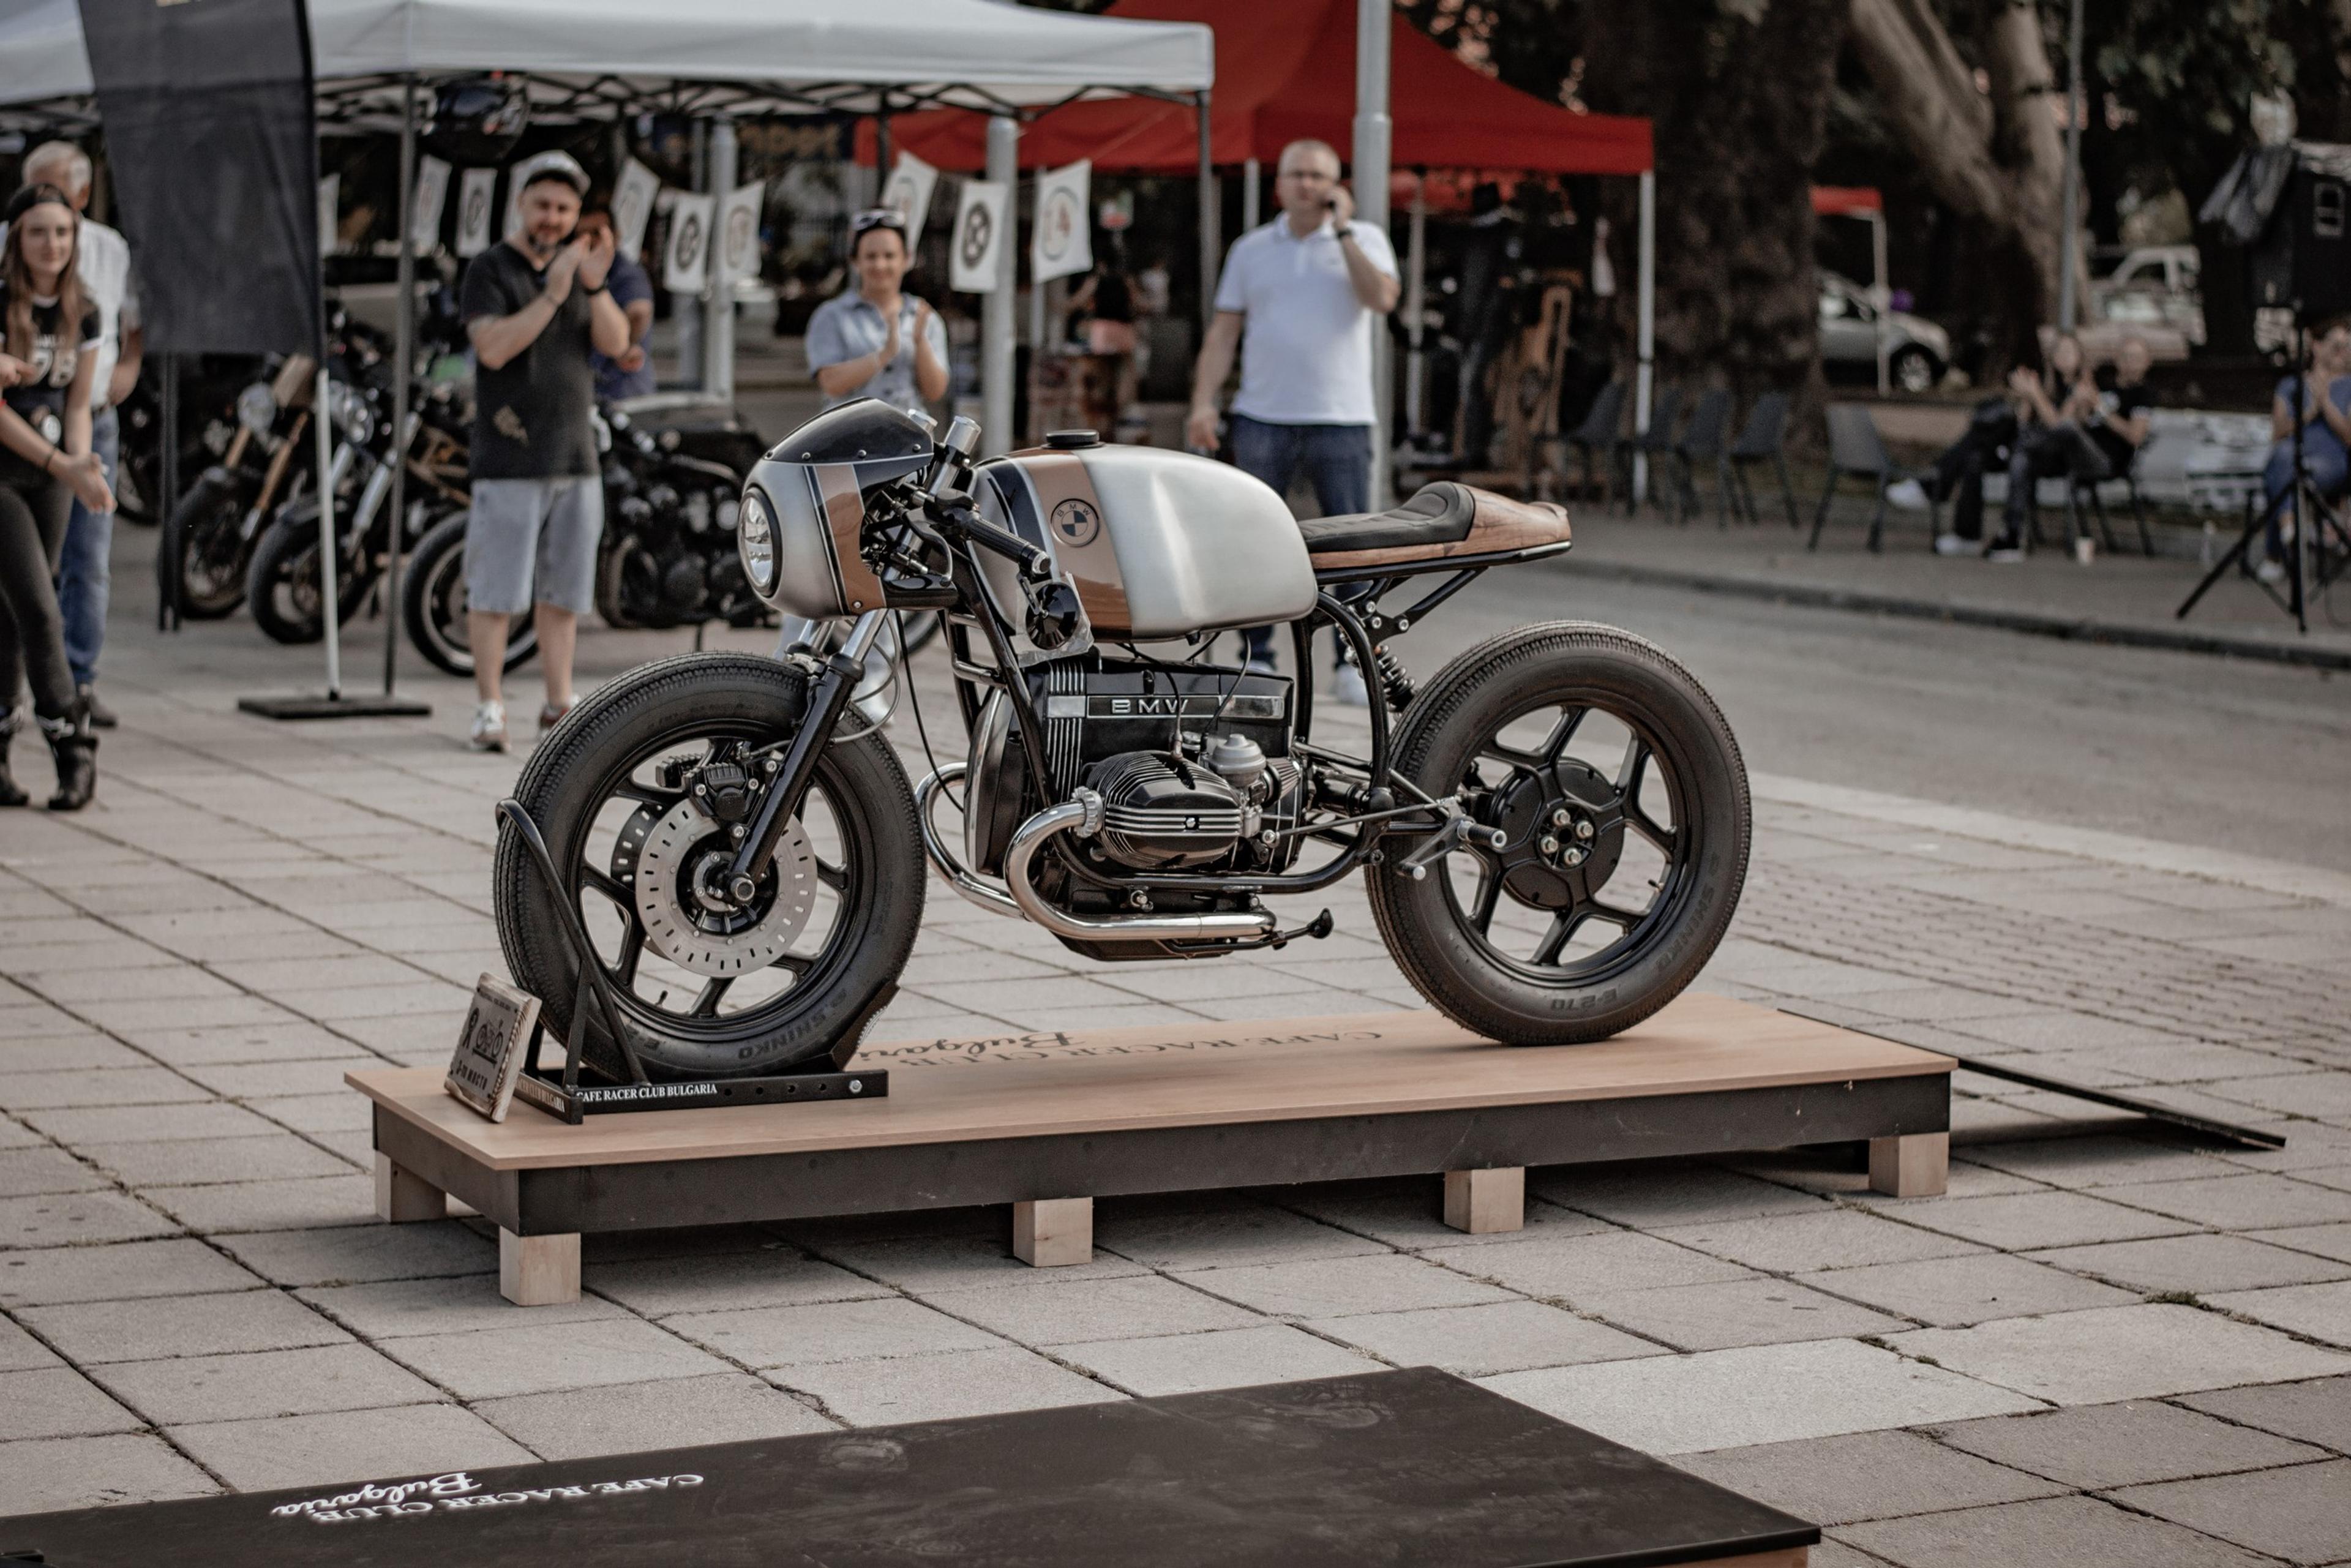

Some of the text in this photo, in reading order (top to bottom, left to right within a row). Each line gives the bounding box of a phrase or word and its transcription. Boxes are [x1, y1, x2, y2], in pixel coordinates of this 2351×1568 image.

[1057, 503, 1091, 517] BMW
[1111, 699, 1188, 714] BMW
[738, 1011, 827, 1060] SHINKO
[858, 1031, 1085, 1061] Bulgari
[899, 1031, 1382, 1066] CAFE RACER CLUB
[576, 1083, 718, 1102] CAFE RACER CLUB BULGARIA
[271, 1472, 482, 1515] Bulgaria
[312, 1474, 703, 1521] CAFE RACER CLUB
